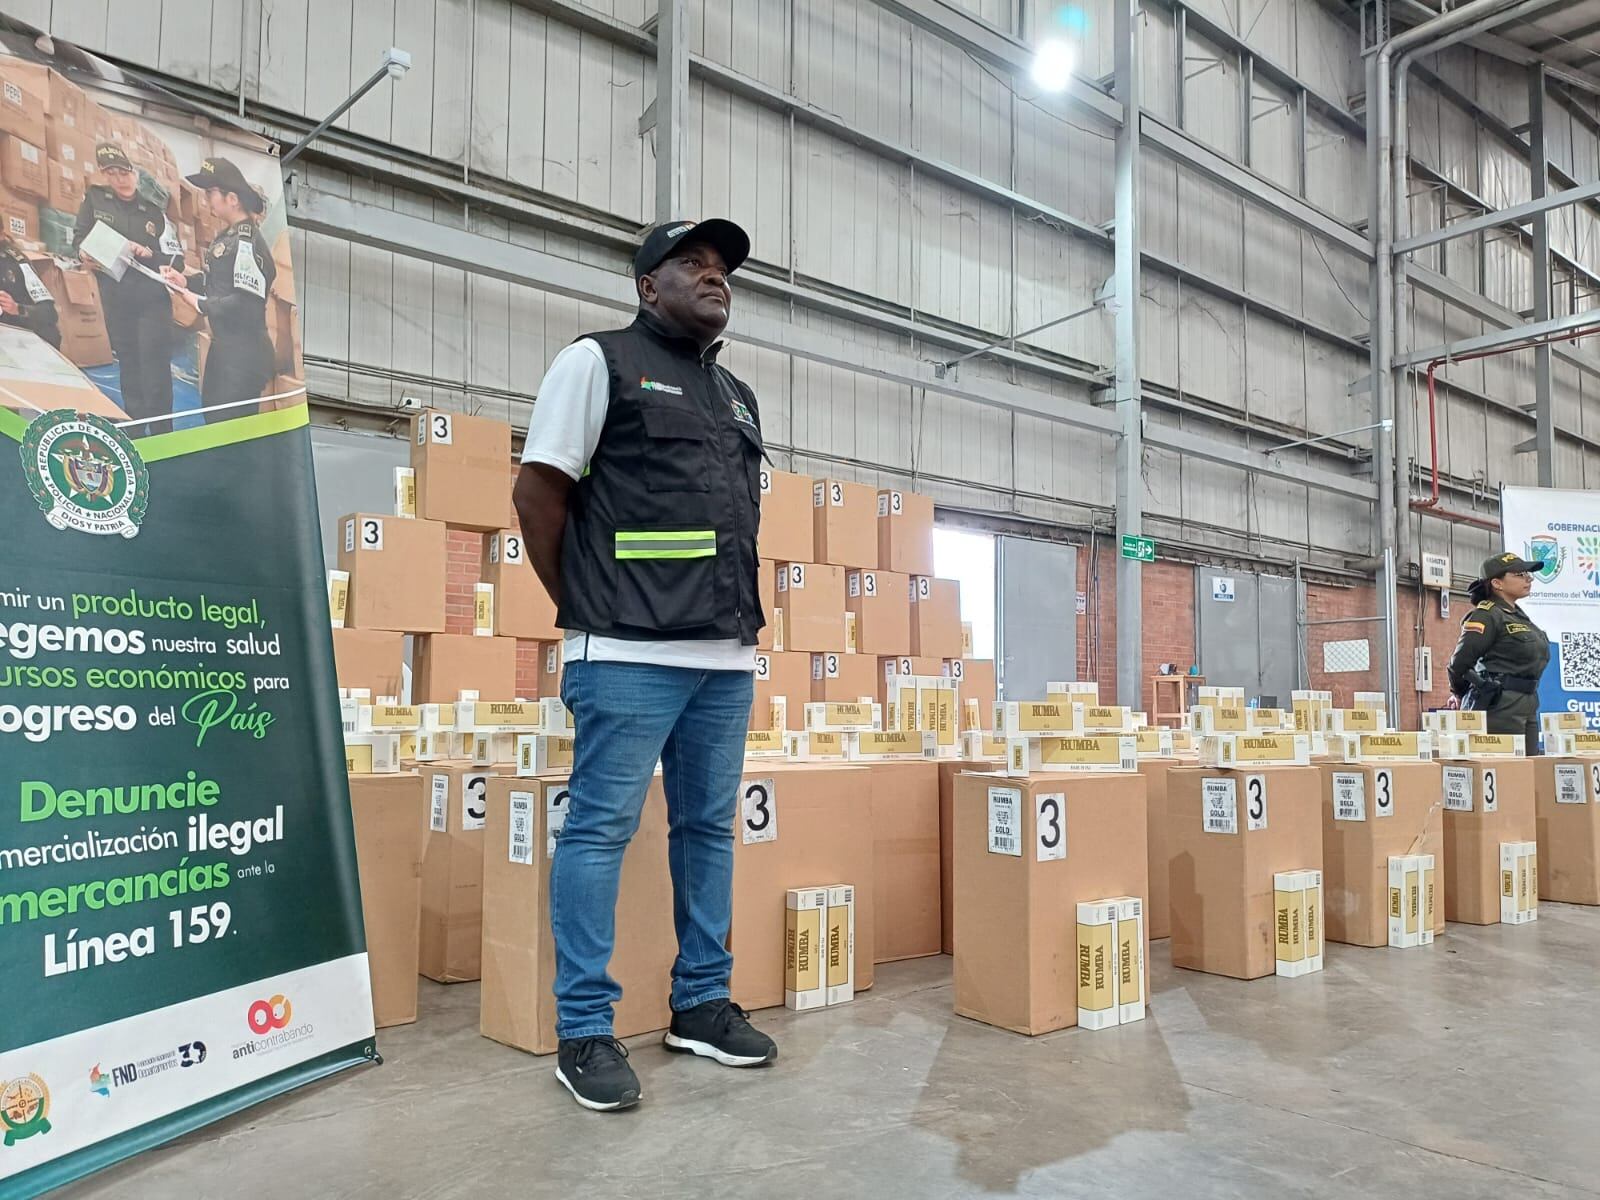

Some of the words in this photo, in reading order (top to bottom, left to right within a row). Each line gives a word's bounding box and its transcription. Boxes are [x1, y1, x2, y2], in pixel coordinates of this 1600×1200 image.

[434, 416, 448, 438] 3
[40, 425, 68, 471] REPUBLICA
[78, 424, 92, 433] DE
[102, 435, 135, 485] COLOMBIA
[760, 471, 769, 490] 3
[48, 483, 83, 516] POLICIA
[93, 496, 132, 519] NACIONAL
[832, 484, 841, 502] 3
[893, 494, 901, 511] 3
[61, 511, 86, 529] DIOS
[94, 520, 126, 531] PATRIA
[364, 521, 379, 544] 3
[507, 538, 520, 559] 3
[792, 566, 802, 584] 3
[866, 574, 874, 592] 3
[920, 579, 928, 596] 3
[1570, 591, 1581, 599] del
[38, 596, 65, 611] un
[72, 589, 192, 619] producto
[201, 595, 266, 628] legal,
[153, 638, 216, 654] nuestra
[227, 633, 280, 655] salud
[757, 657, 767, 676] 3
[828, 656, 837, 674] 3
[902, 659, 911, 675] 3
[954, 661, 962, 678] 3
[86, 663, 246, 689] económicos
[254, 675, 290, 693] para
[385, 707, 413, 717] RUMBA
[490, 704, 524, 715] RUMBA
[836, 704, 861, 715] RUMBA
[1032, 705, 1060, 717] RUMBA
[1089, 708, 1112, 718] RUMBA
[1221, 709, 1239, 719] RUMBA
[1257, 709, 1273, 718] RUMBA
[1351, 711, 1369, 721] RUMBA
[1461, 712, 1476, 721] RUMBA
[1567, 699, 1600, 717] Grup
[0, 705, 137, 742] ogreso
[149, 707, 176, 727] del
[181, 689, 276, 747] País
[817, 733, 834, 744] RUMBA
[874, 733, 907, 743] RUMBA
[1060, 739, 1100, 751] RUMBA
[1243, 738, 1278, 749] RUMBA
[1370, 736, 1402, 746] RUMBA
[1474, 737, 1502, 745] RUMBA
[21, 771, 220, 822] Denuncie
[1377, 772, 1390, 807] 3
[1485, 772, 1495, 804] 3
[745, 784, 770, 831] 3
[993, 796, 1013, 805] RUMBA
[1249, 779, 1263, 820] 3
[1040, 798, 1061, 848] 3
[0, 826, 178, 869] mercialización
[188, 805, 284, 856] ilegal
[0, 857, 230, 924] mercancías
[237, 864, 262, 879] ante
[264, 861, 275, 875] la
[1278, 908, 1289, 945] RUMBA
[44, 925, 155, 977] Línea
[787, 928, 795, 970] RUMBA
[798, 928, 809, 972] RUMBA
[830, 924, 840, 968] RUMBA
[1080, 944, 1091, 988] RUMBA
[1096, 944, 1104, 991] RUMBA
[1121, 940, 1131, 985] RUMBA
[232, 1023, 314, 1060] anticontrabando
[112, 1063, 138, 1088] FND
